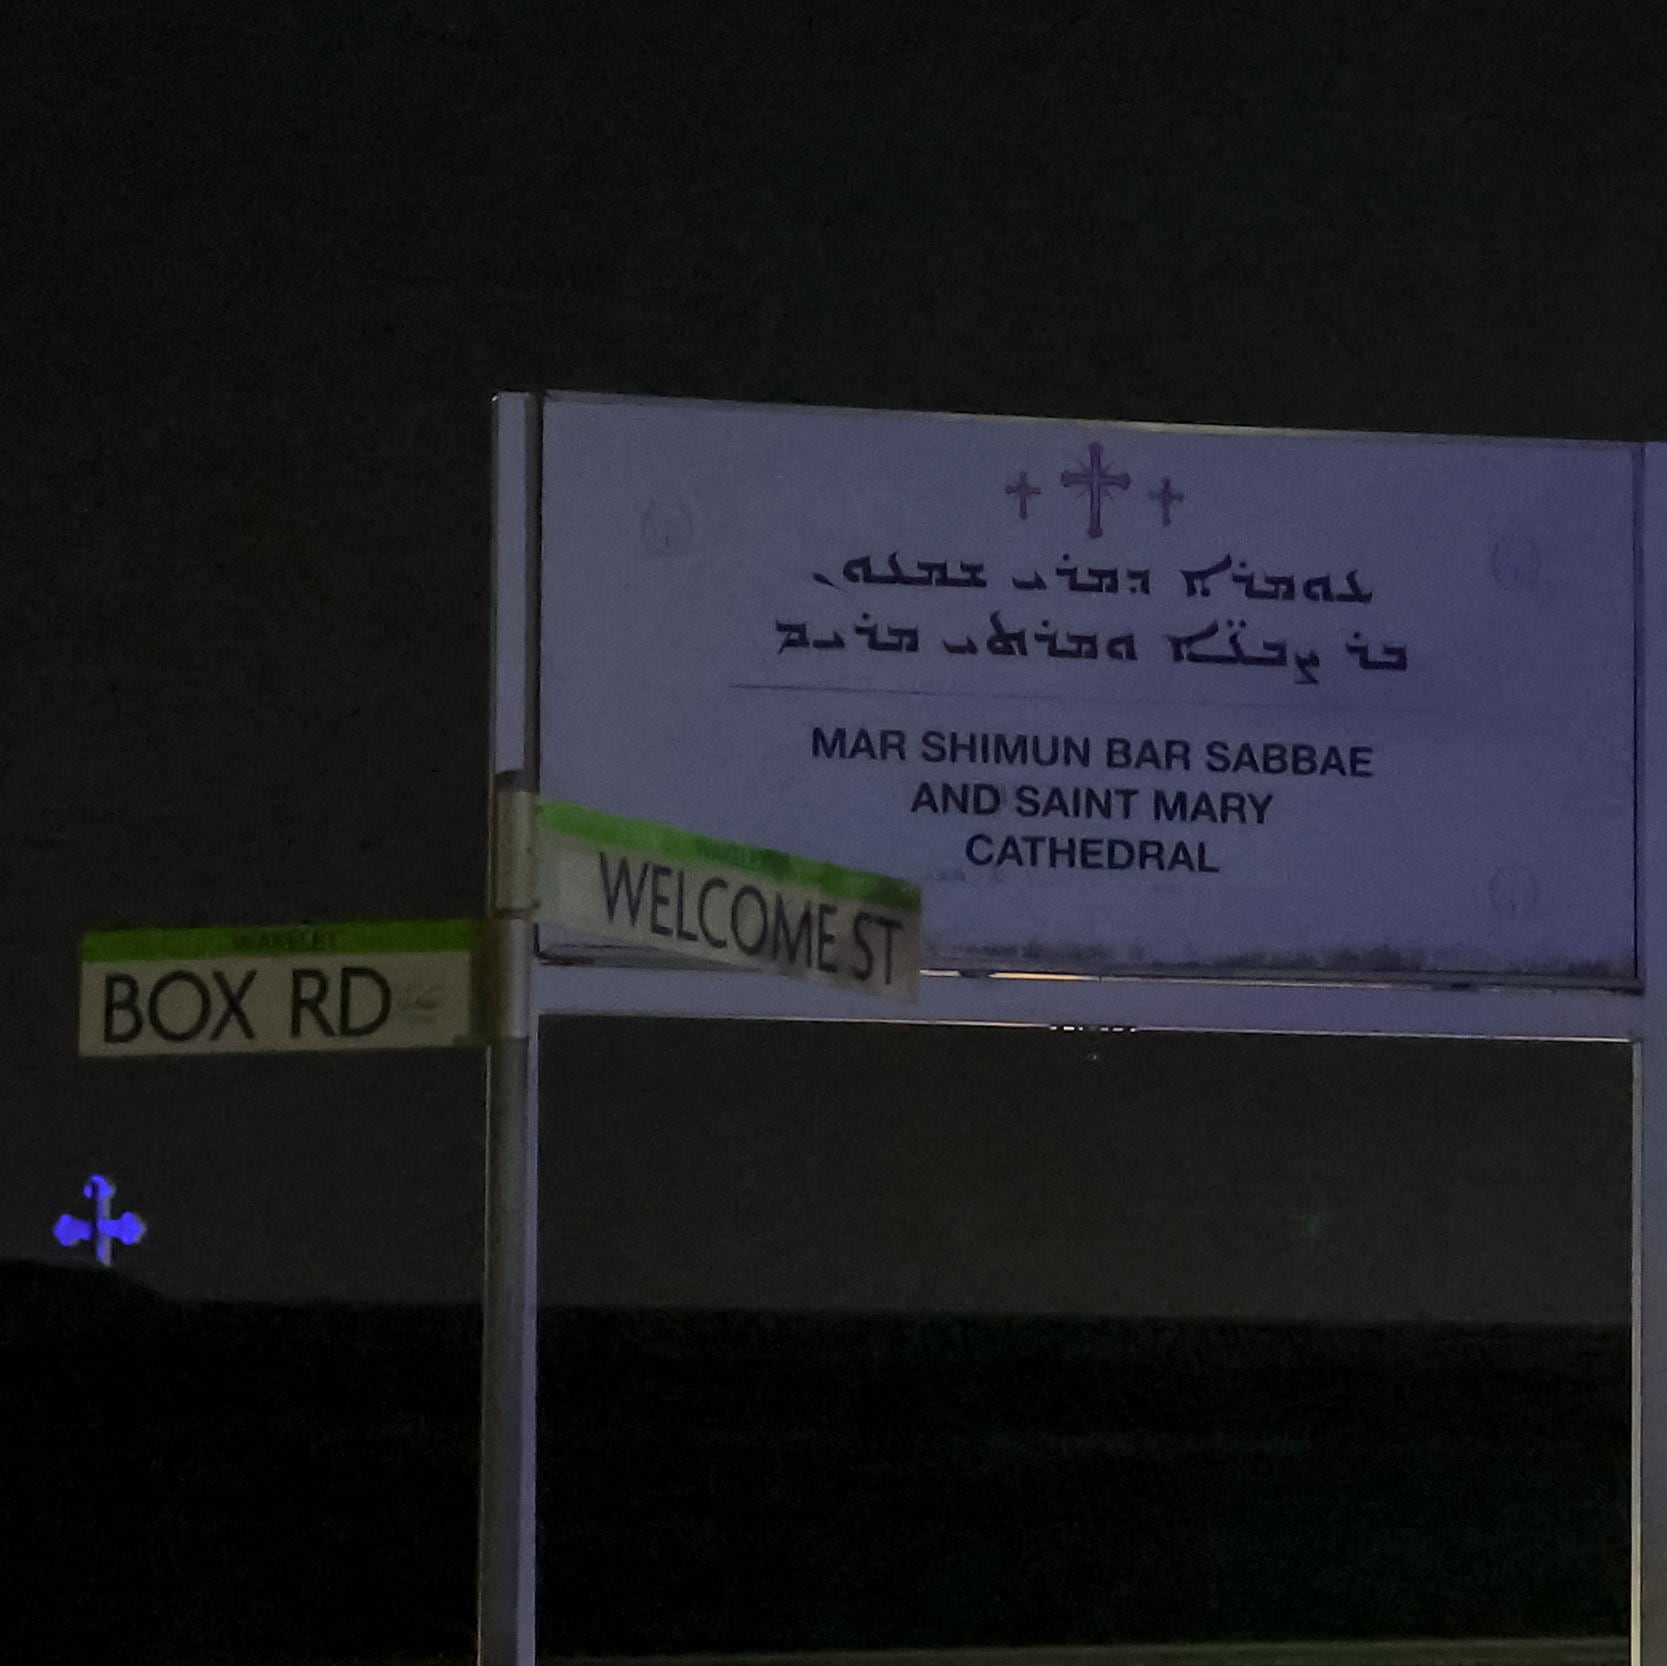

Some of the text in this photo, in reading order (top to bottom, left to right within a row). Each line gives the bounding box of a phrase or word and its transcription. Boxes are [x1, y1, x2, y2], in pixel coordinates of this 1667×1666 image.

[811, 726, 1374, 778] MAR SHIMUN BAR SABBAE
[910, 782, 1274, 825] AND SAINT MARY
[965, 833, 1220, 873] CATHEDRAL
[602, 853, 840, 975] WELCOME
[851, 911, 904, 987] ST
[103, 966, 395, 1045] BOX RD
